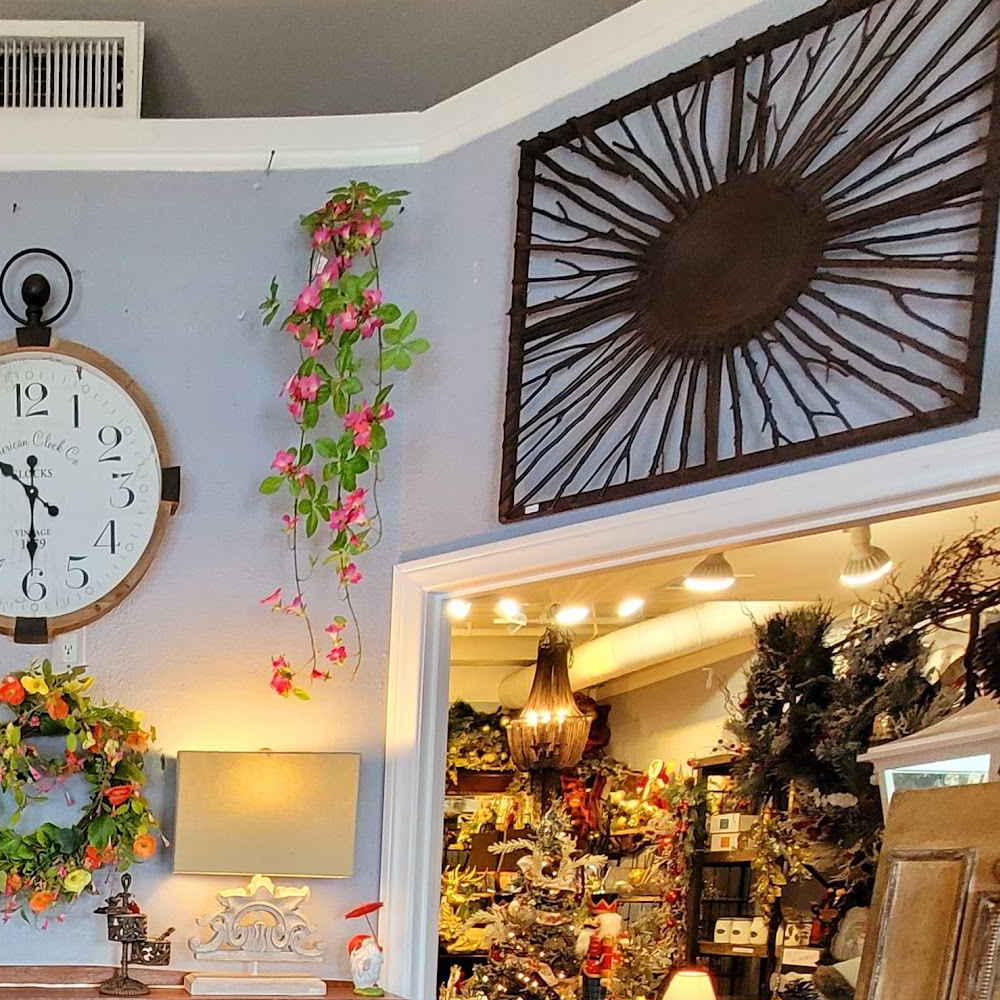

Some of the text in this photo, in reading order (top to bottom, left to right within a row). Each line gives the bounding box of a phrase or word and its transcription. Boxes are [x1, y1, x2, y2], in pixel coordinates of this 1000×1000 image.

[14, 382, 49, 418] 12
[72, 394, 80, 429] 1
[32, 430, 66, 454] Clock
[97, 425, 123, 463] 2
[13, 468, 53, 479] LOCKS
[109, 471, 136, 509] 3
[14, 528, 52, 537] VINAGE
[21, 538, 47, 549] 19
[93, 519, 121, 554] 4
[21, 567, 47, 602] 6
[65, 555, 89, 590] 5
